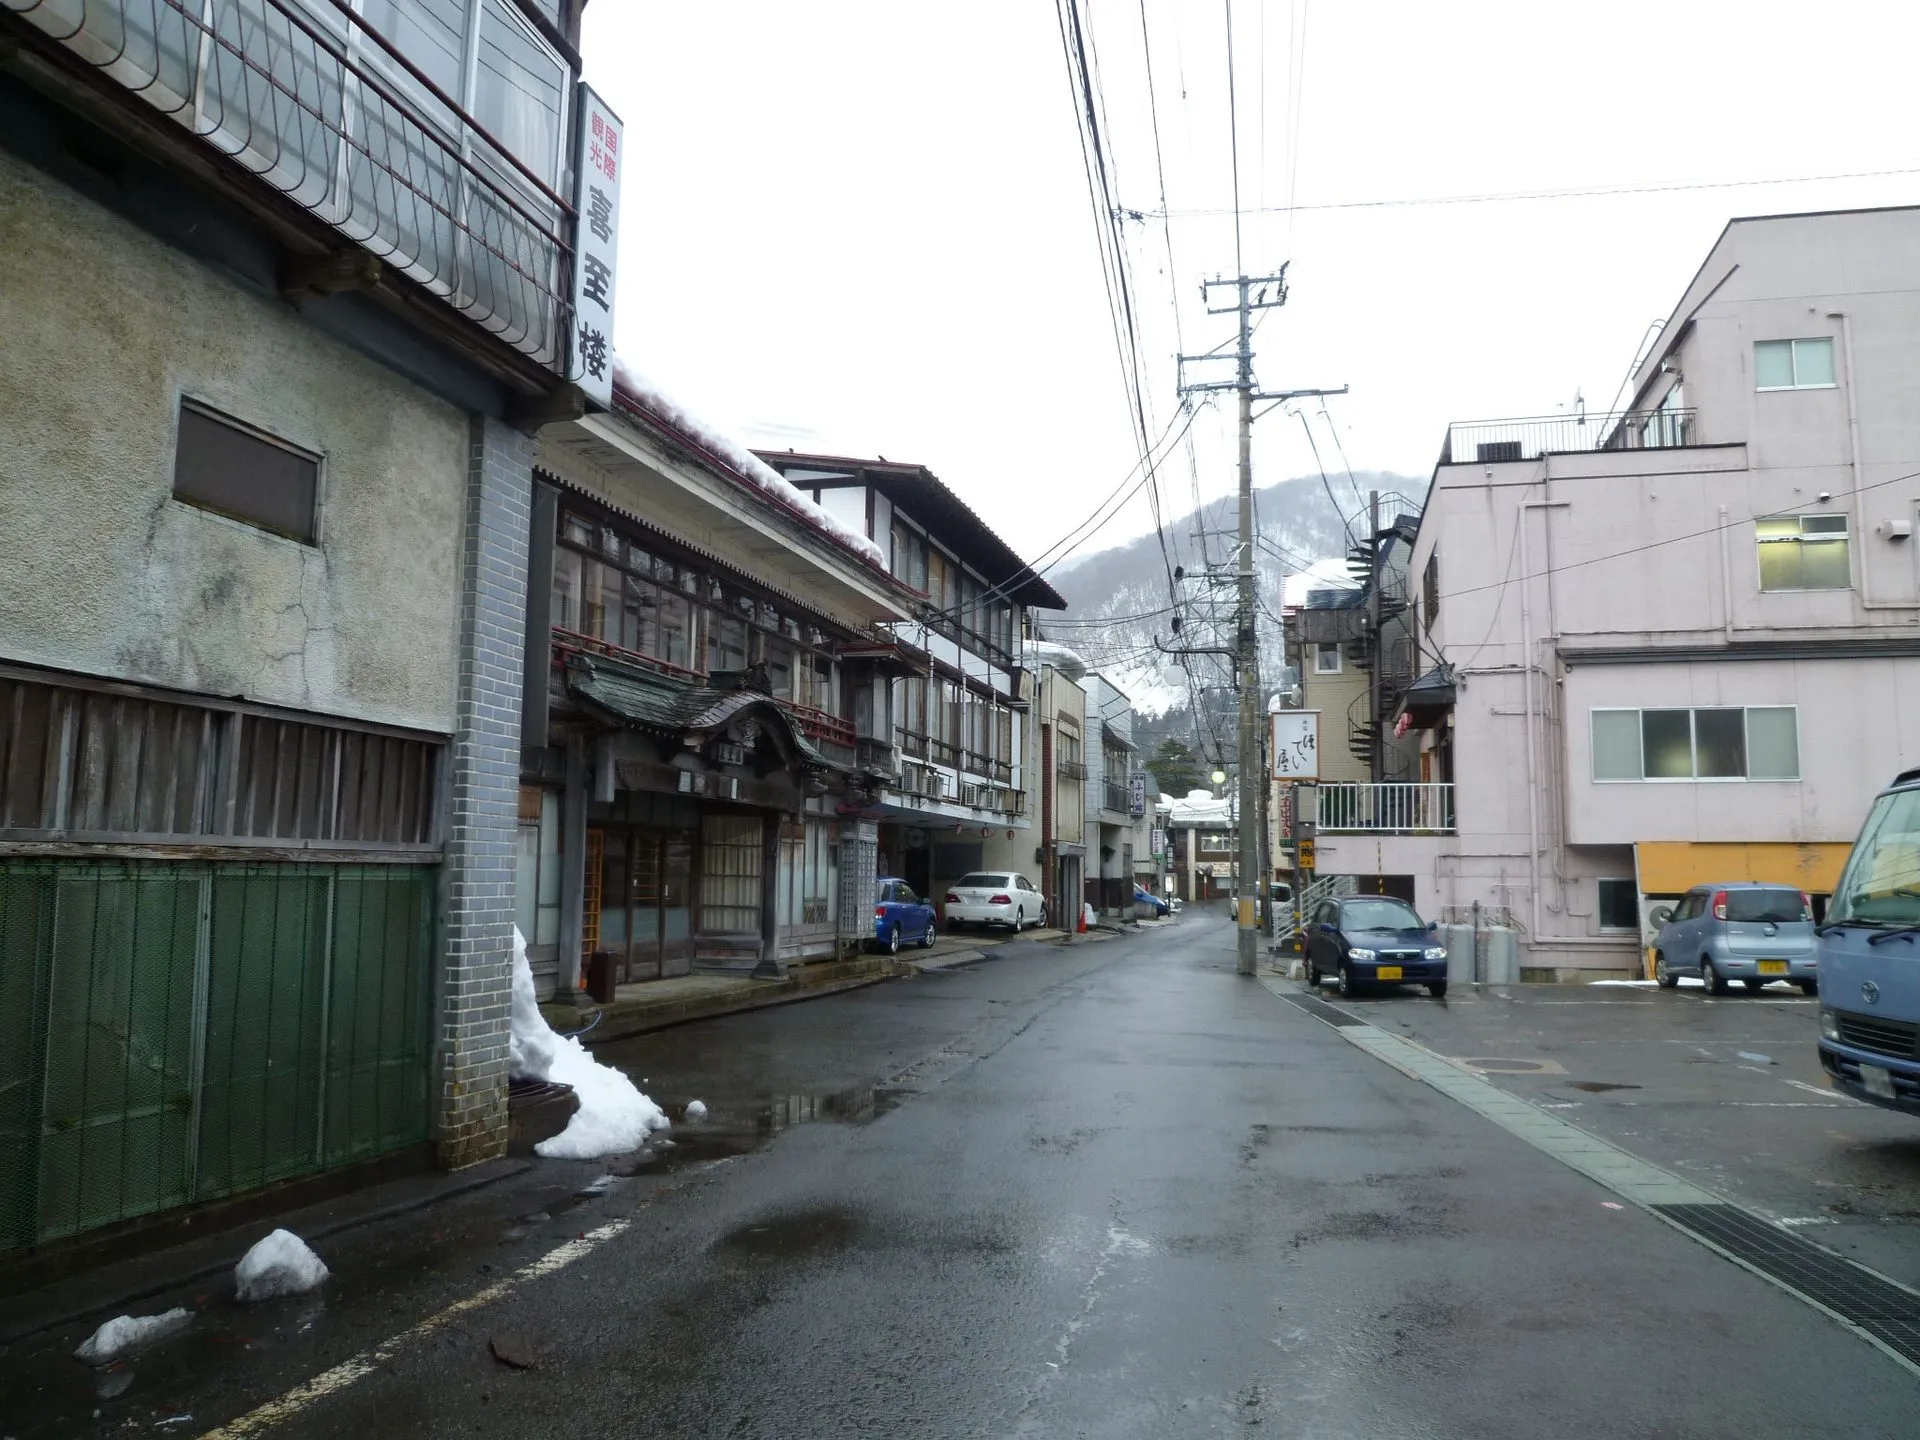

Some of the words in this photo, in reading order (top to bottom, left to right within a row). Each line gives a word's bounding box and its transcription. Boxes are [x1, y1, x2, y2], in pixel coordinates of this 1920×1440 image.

[590, 110, 604, 170] 観光
[603, 124, 617, 183] 国際
[579, 184, 613, 382] 喜至楼
